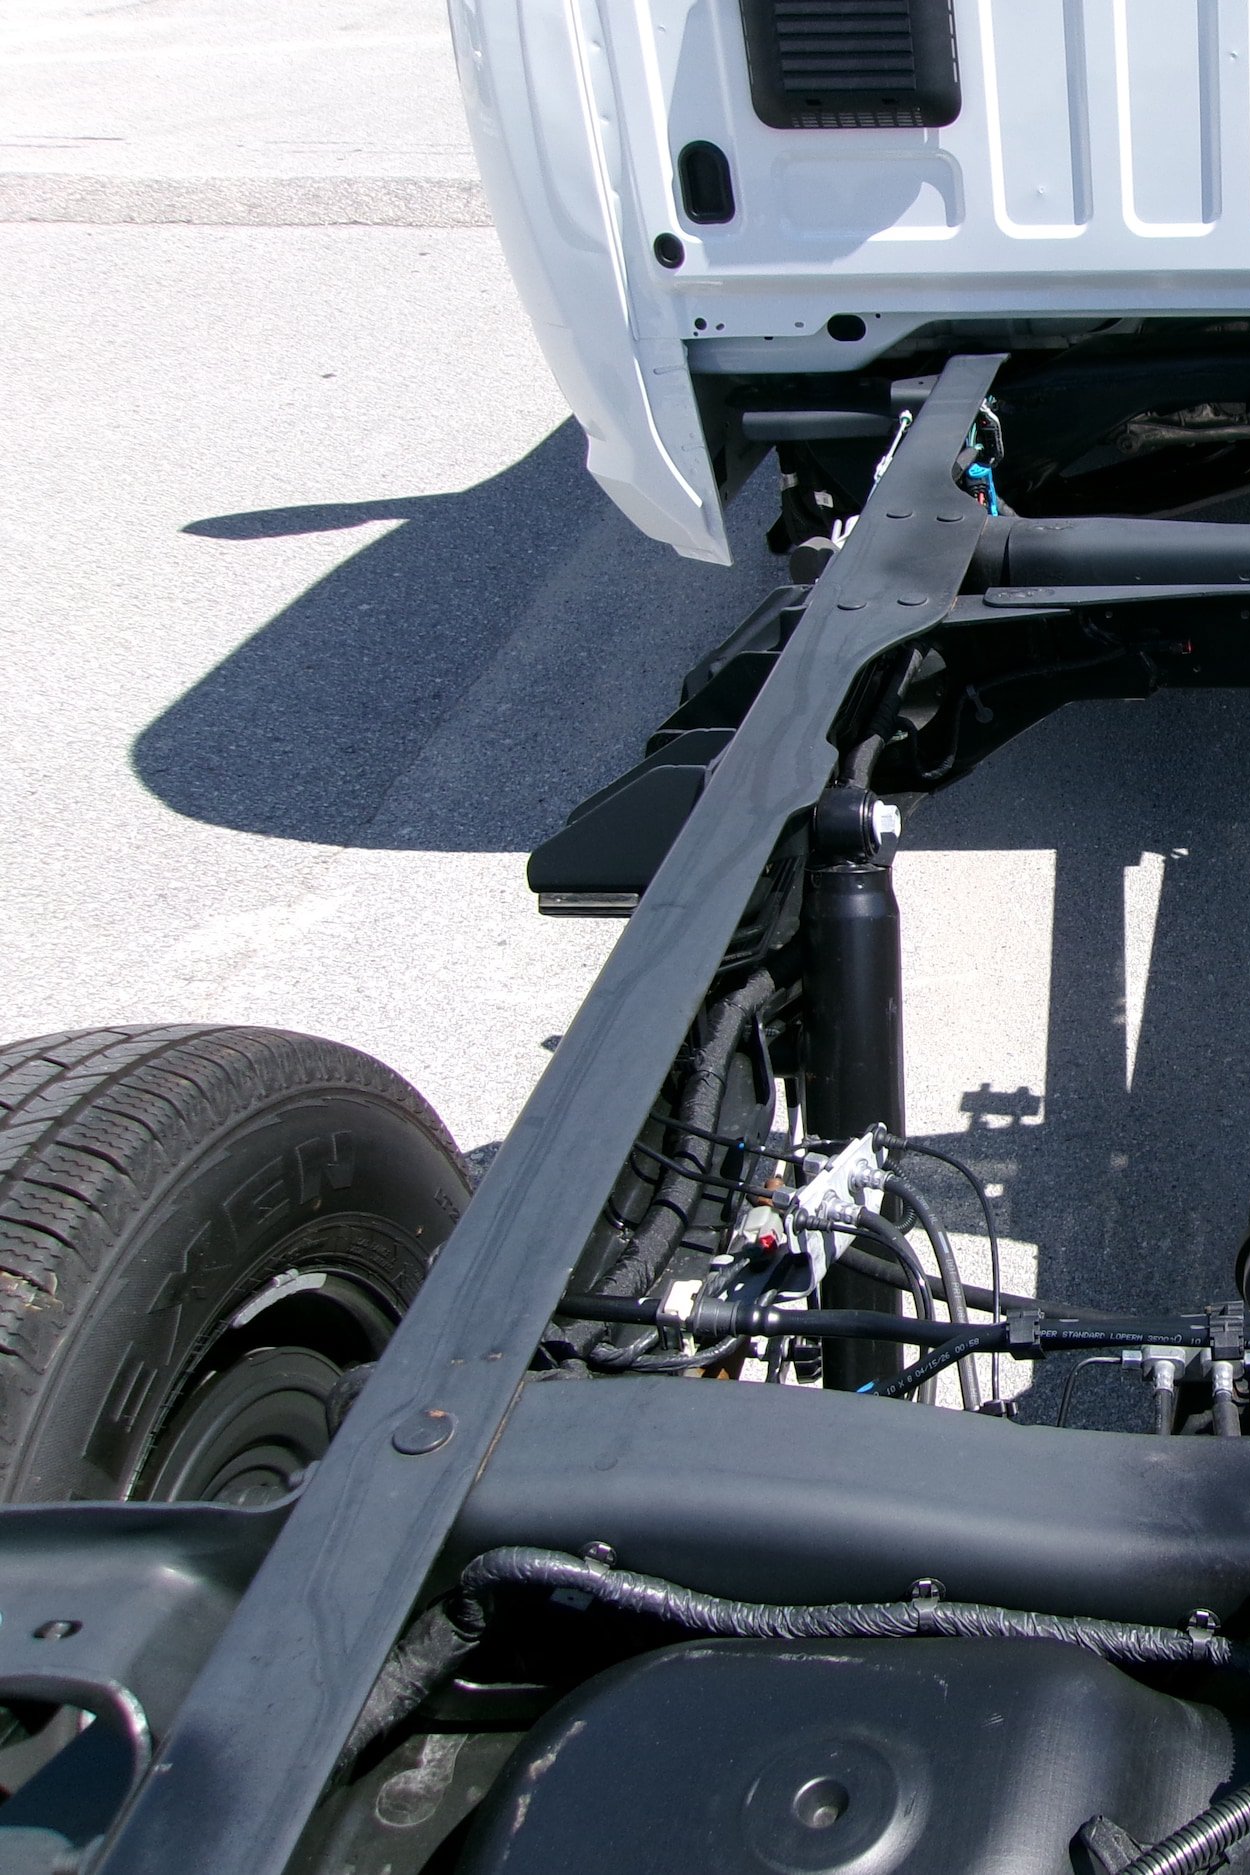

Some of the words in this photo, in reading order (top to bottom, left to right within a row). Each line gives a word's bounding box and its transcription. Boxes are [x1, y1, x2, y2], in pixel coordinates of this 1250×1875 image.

[1062, 1330, 1106, 1340] STANDARD
[1110, 1332, 1143, 1342] LOPERM
[886, 1385, 897, 1396] 10
[914, 1351, 951, 1378] 04/15/26
[954, 1337, 980, 1354] 00:58
